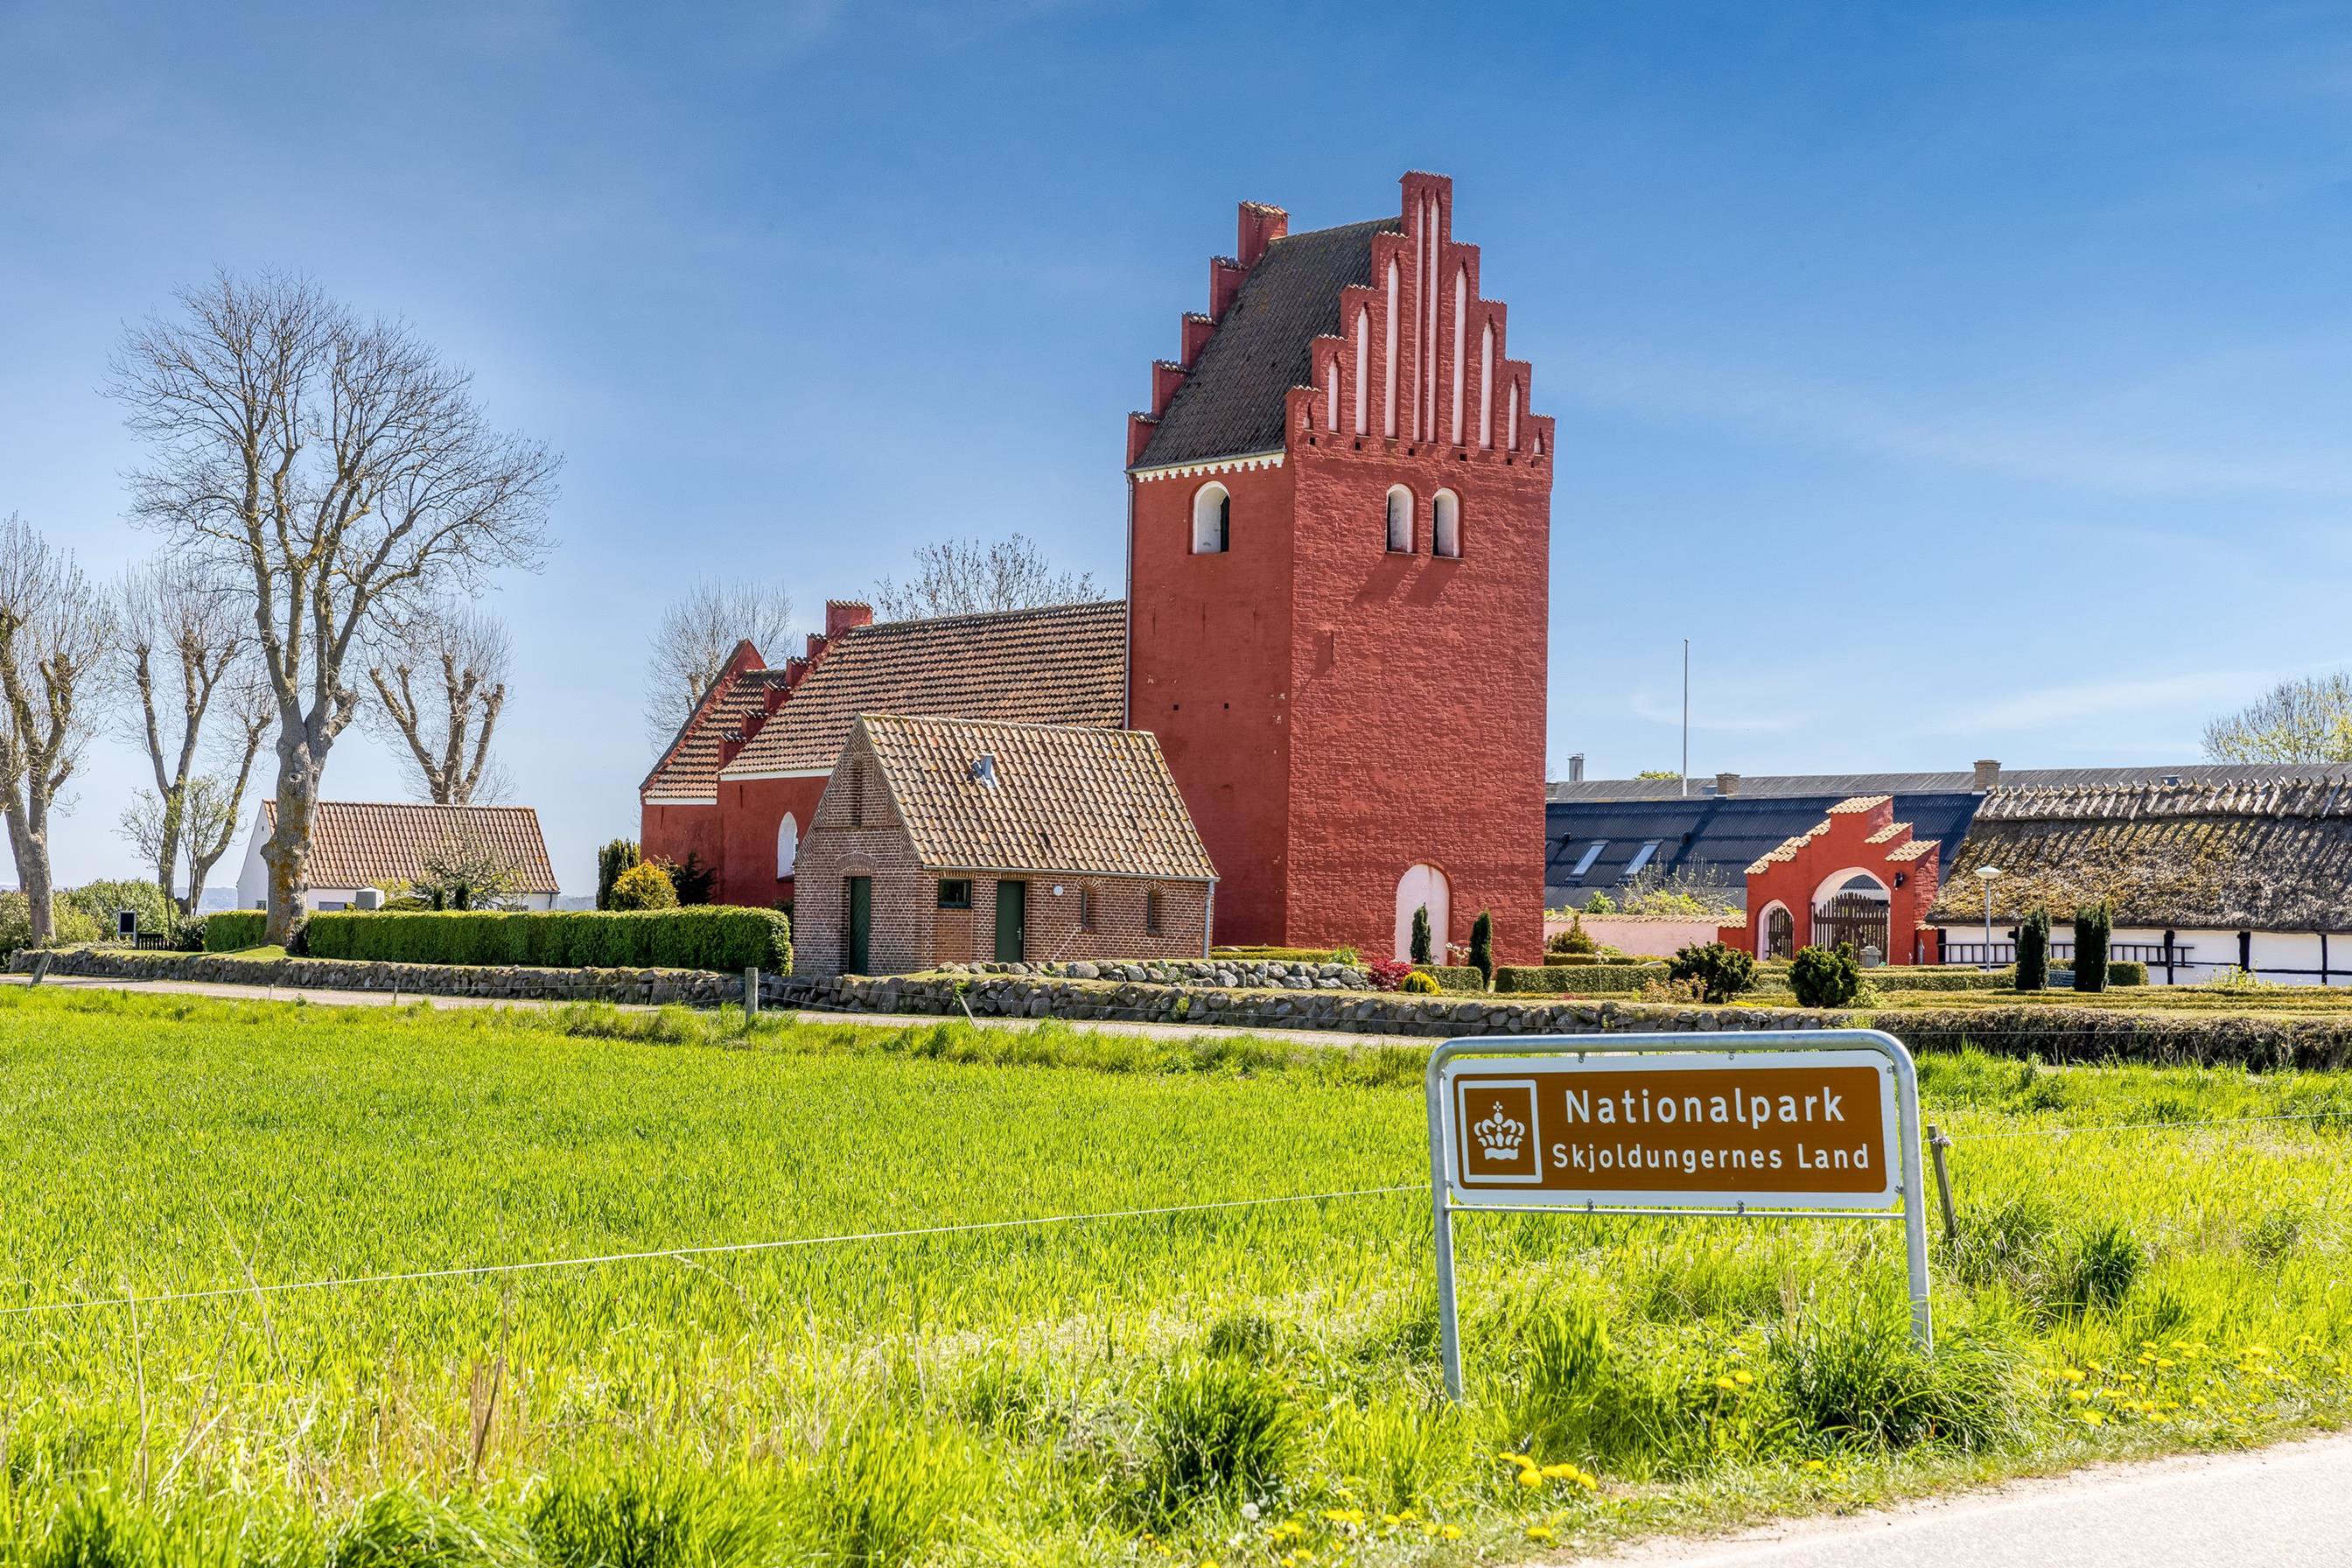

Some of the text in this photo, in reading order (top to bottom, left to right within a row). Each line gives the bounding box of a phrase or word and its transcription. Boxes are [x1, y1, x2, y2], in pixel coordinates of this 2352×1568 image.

[1565, 1086, 1845, 1130] Nationalpark
[1552, 1143, 1869, 1173] Skjoldungernes Land
